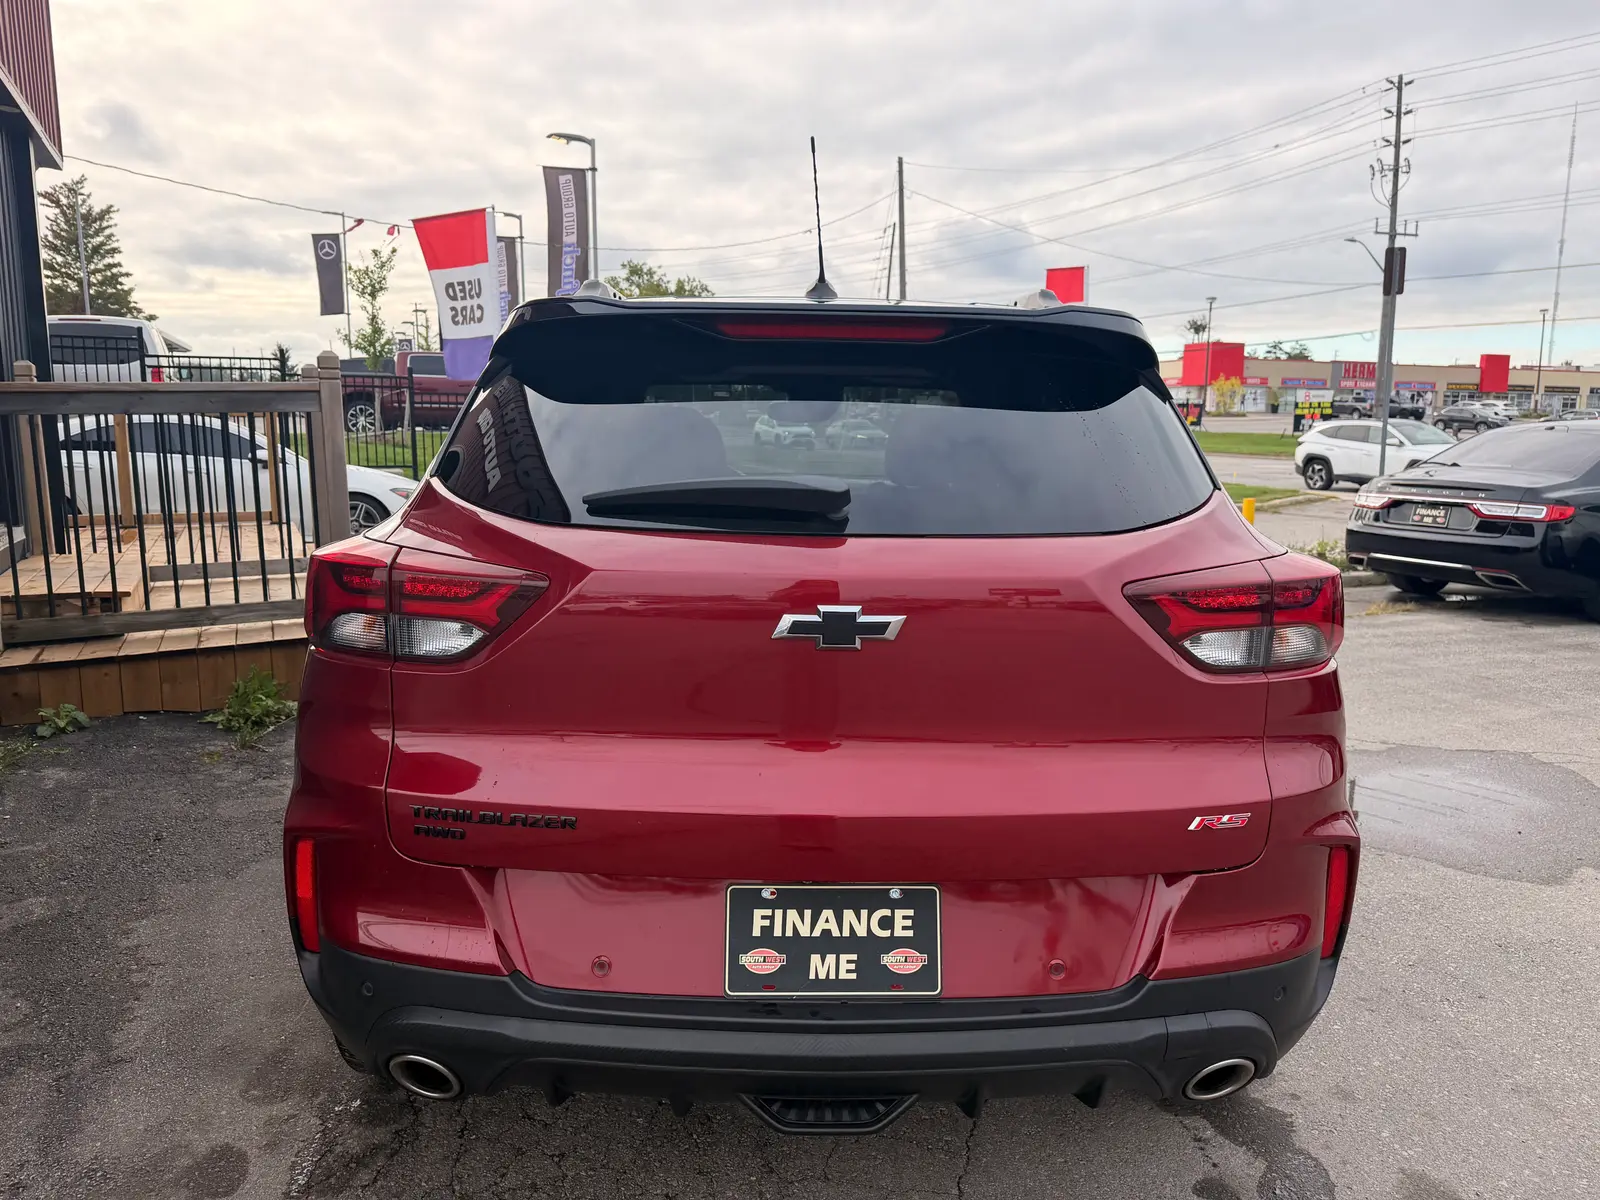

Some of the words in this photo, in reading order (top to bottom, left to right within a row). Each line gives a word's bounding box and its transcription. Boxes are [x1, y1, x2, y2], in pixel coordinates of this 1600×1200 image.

[1342, 362, 1377, 378] HERM
[1416, 507, 1446, 516] FINANCE
[409, 804, 578, 830] TRAILBLAZER
[1187, 812, 1252, 831] RS
[413, 825, 466, 840] AWD
[752, 908, 915, 938] FINANCE
[808, 953, 858, 980] ME
